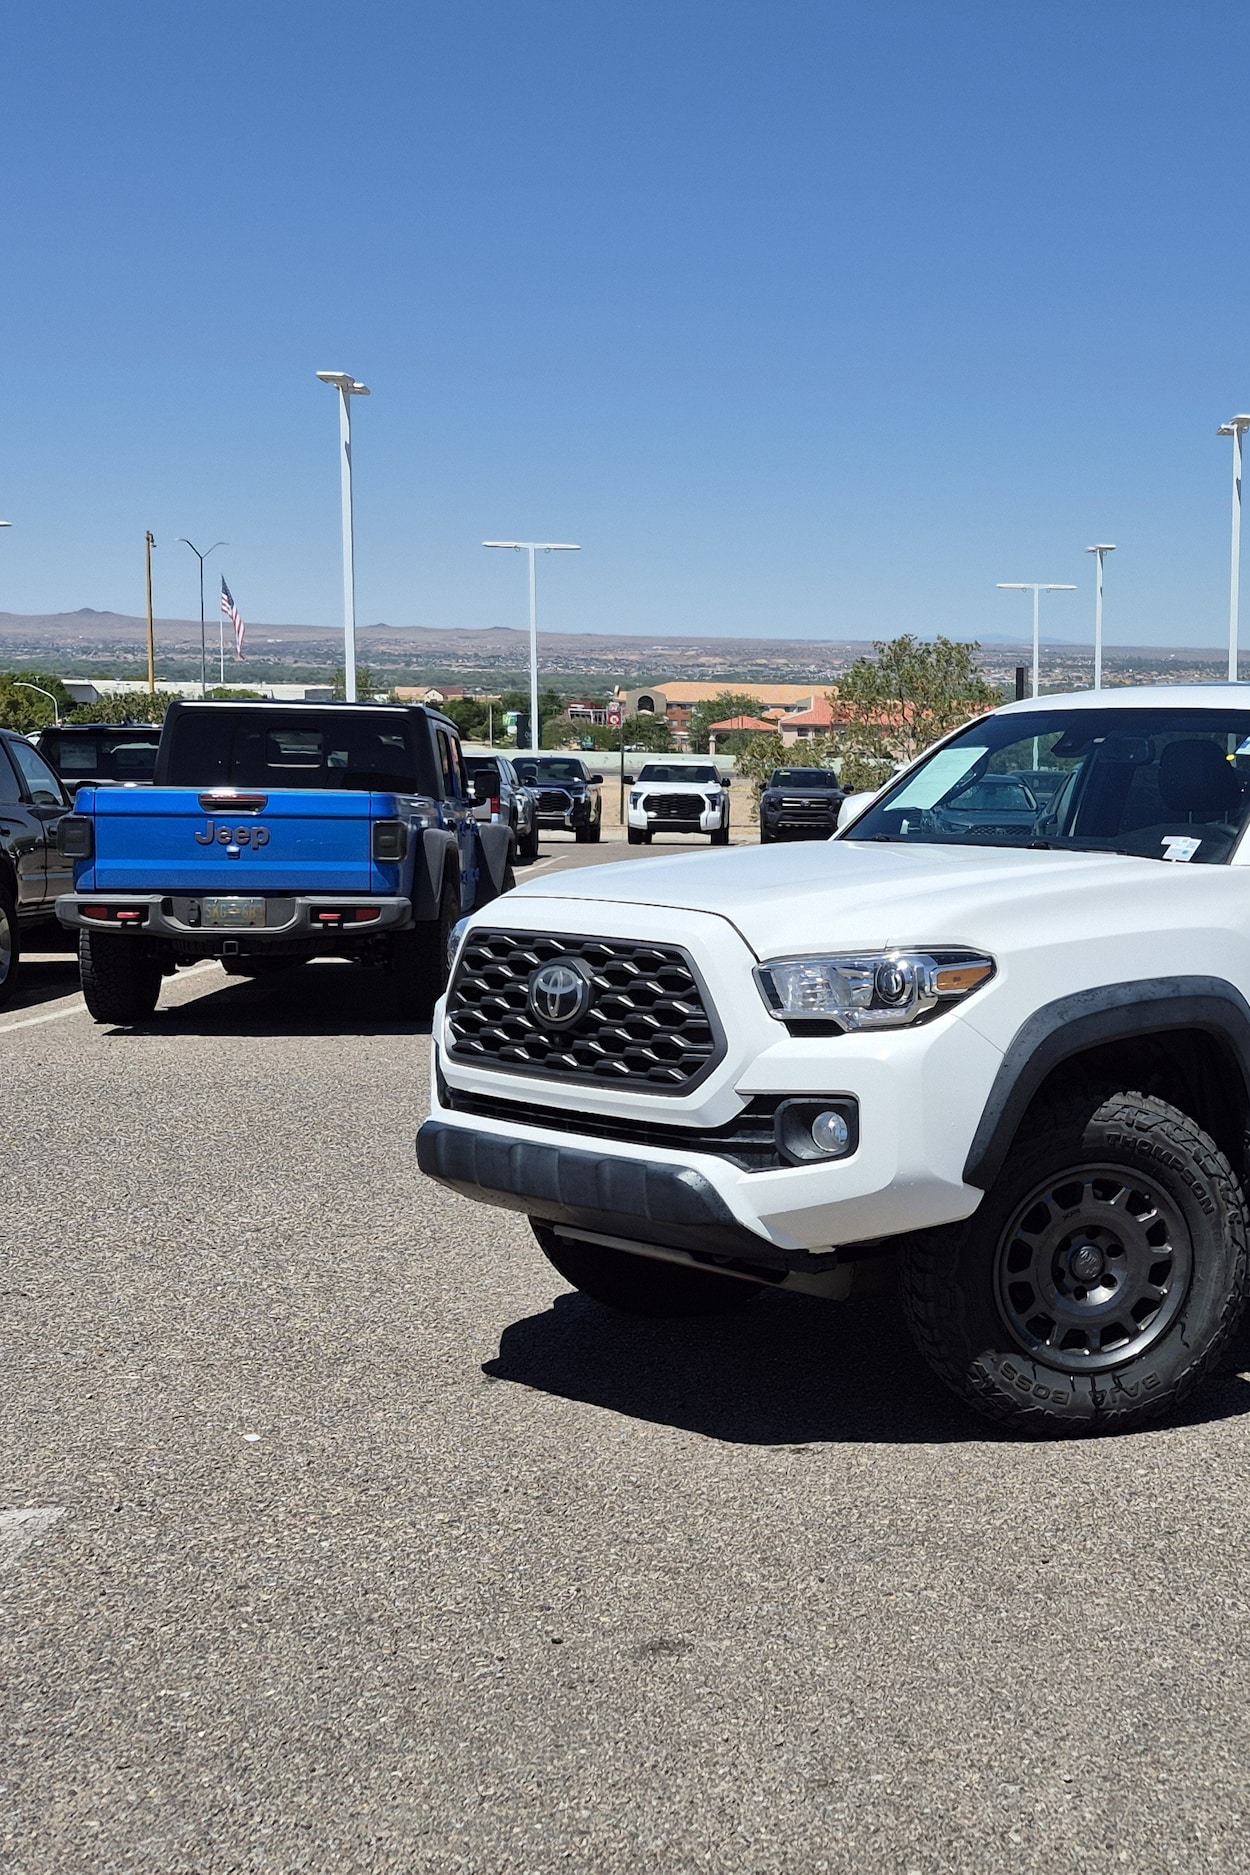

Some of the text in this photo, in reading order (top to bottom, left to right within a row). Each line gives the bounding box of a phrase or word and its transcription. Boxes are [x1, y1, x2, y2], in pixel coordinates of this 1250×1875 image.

[194, 820, 270, 849] Jeep
[1105, 1130, 1216, 1216] THOMPSON
[999, 1360, 1071, 1407] BOSS
